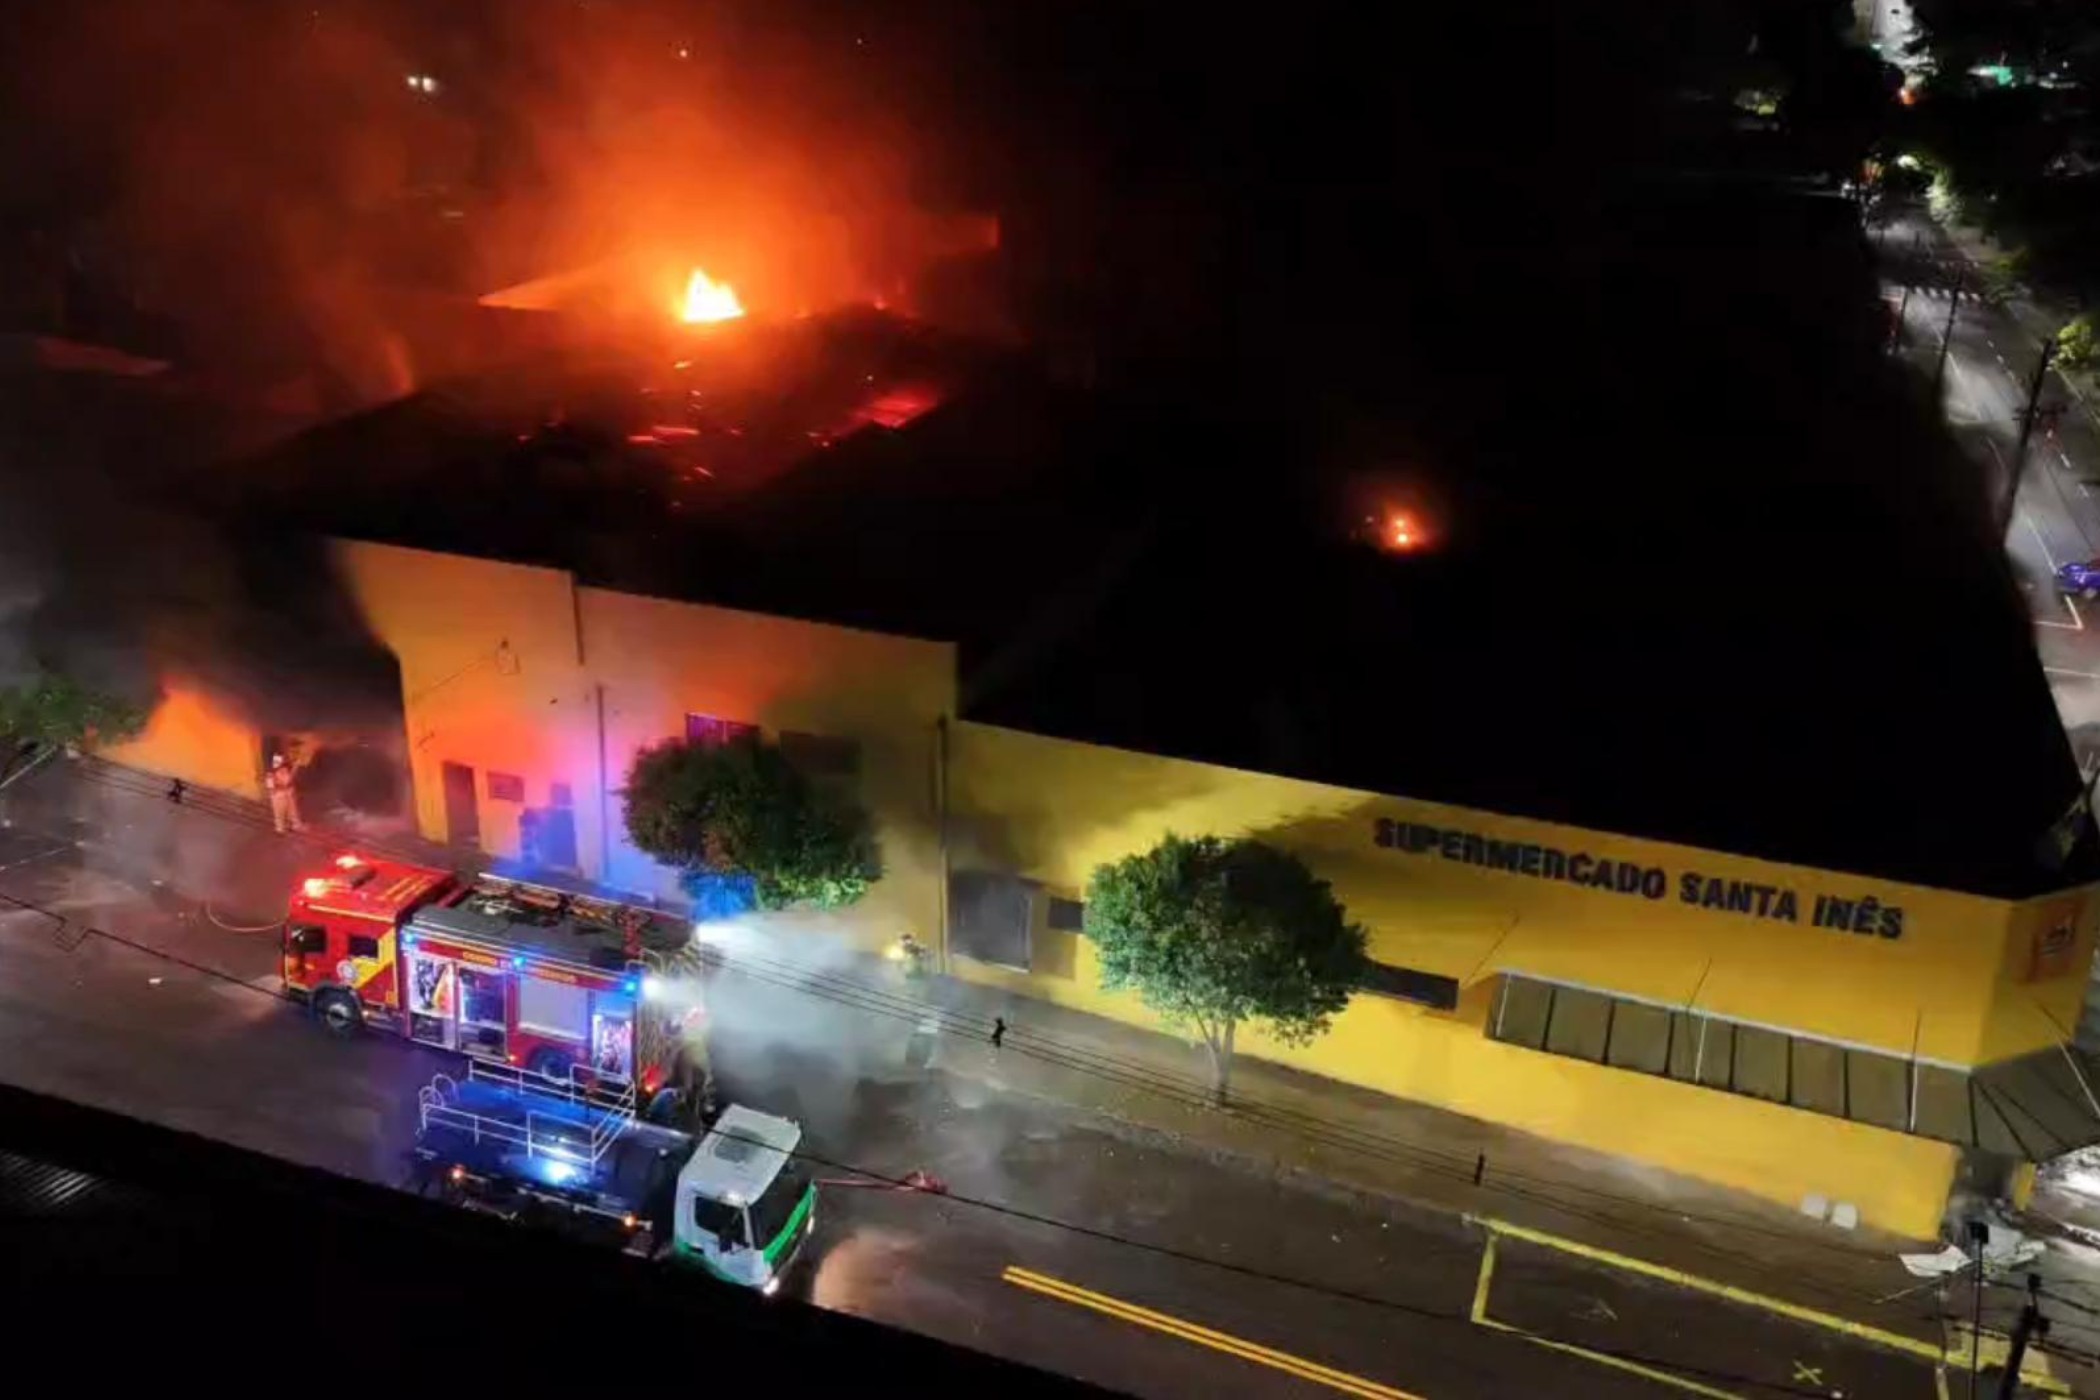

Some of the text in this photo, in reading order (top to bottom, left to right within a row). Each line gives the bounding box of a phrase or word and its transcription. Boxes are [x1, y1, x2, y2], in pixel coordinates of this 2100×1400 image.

[1374, 817, 1903, 940] SUPERMERCADO SANTA INÊS
